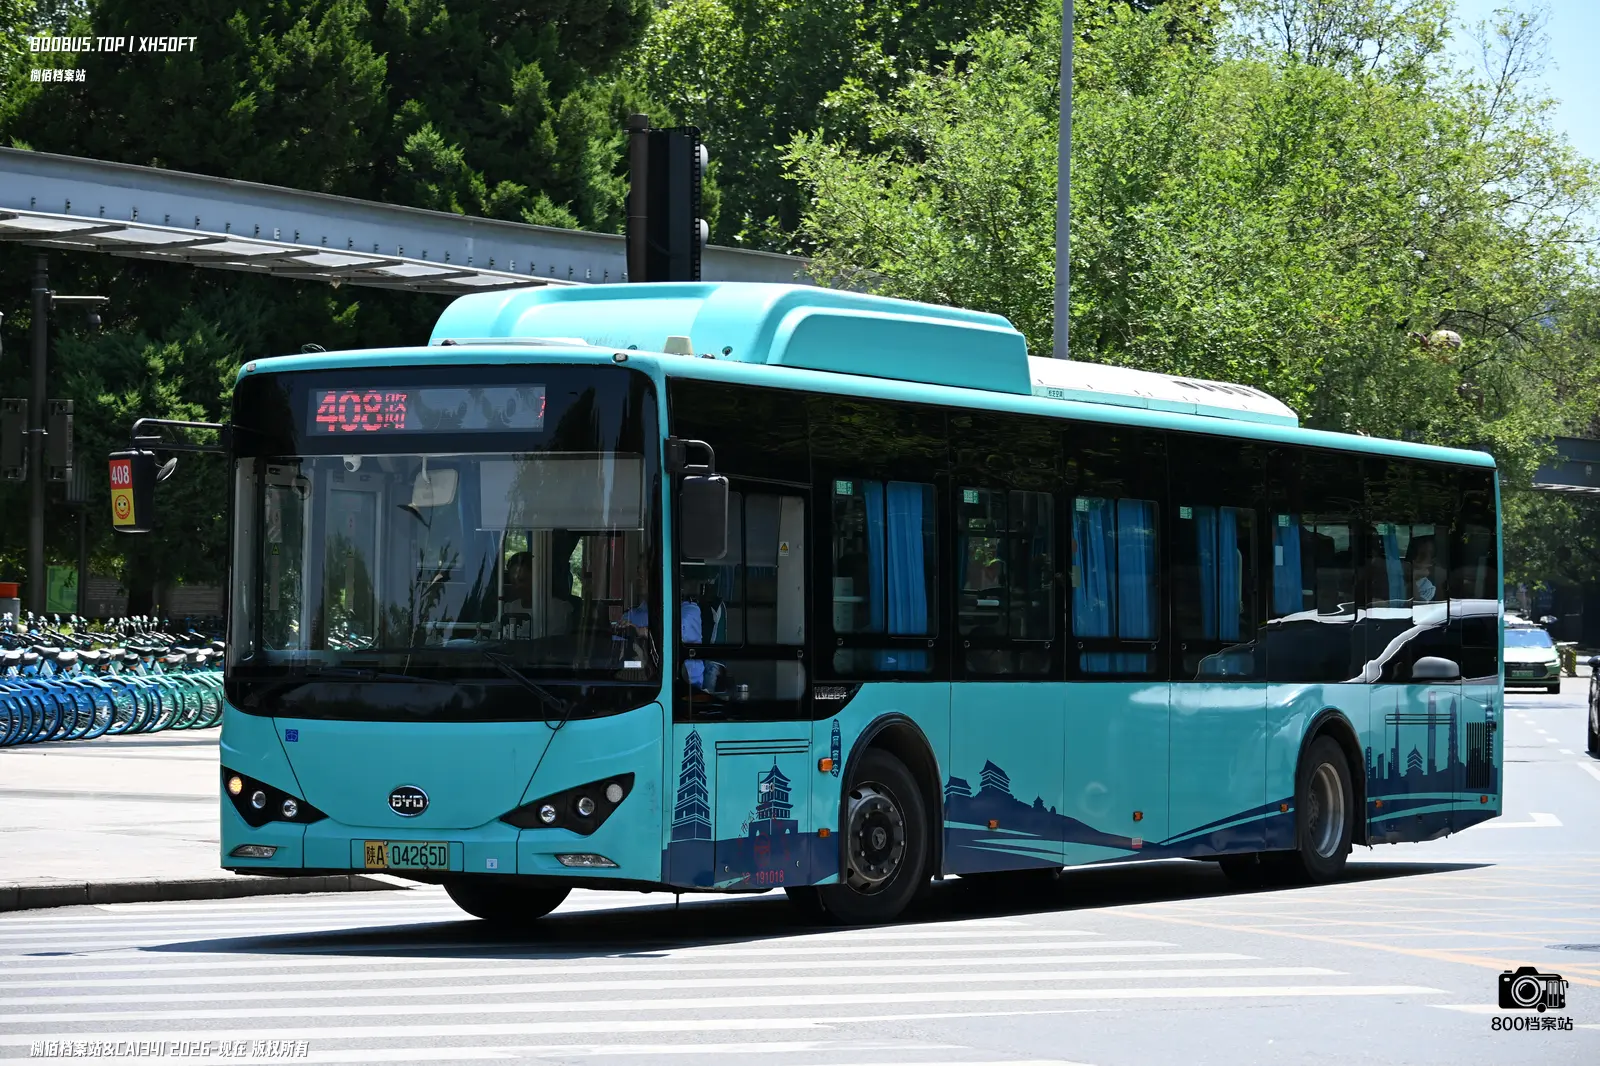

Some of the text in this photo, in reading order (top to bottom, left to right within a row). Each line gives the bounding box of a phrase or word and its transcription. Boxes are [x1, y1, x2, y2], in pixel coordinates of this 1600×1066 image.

[111, 465, 130, 484] 408
[392, 794, 424, 808] BYD
[756, 870, 784, 885] 191018
